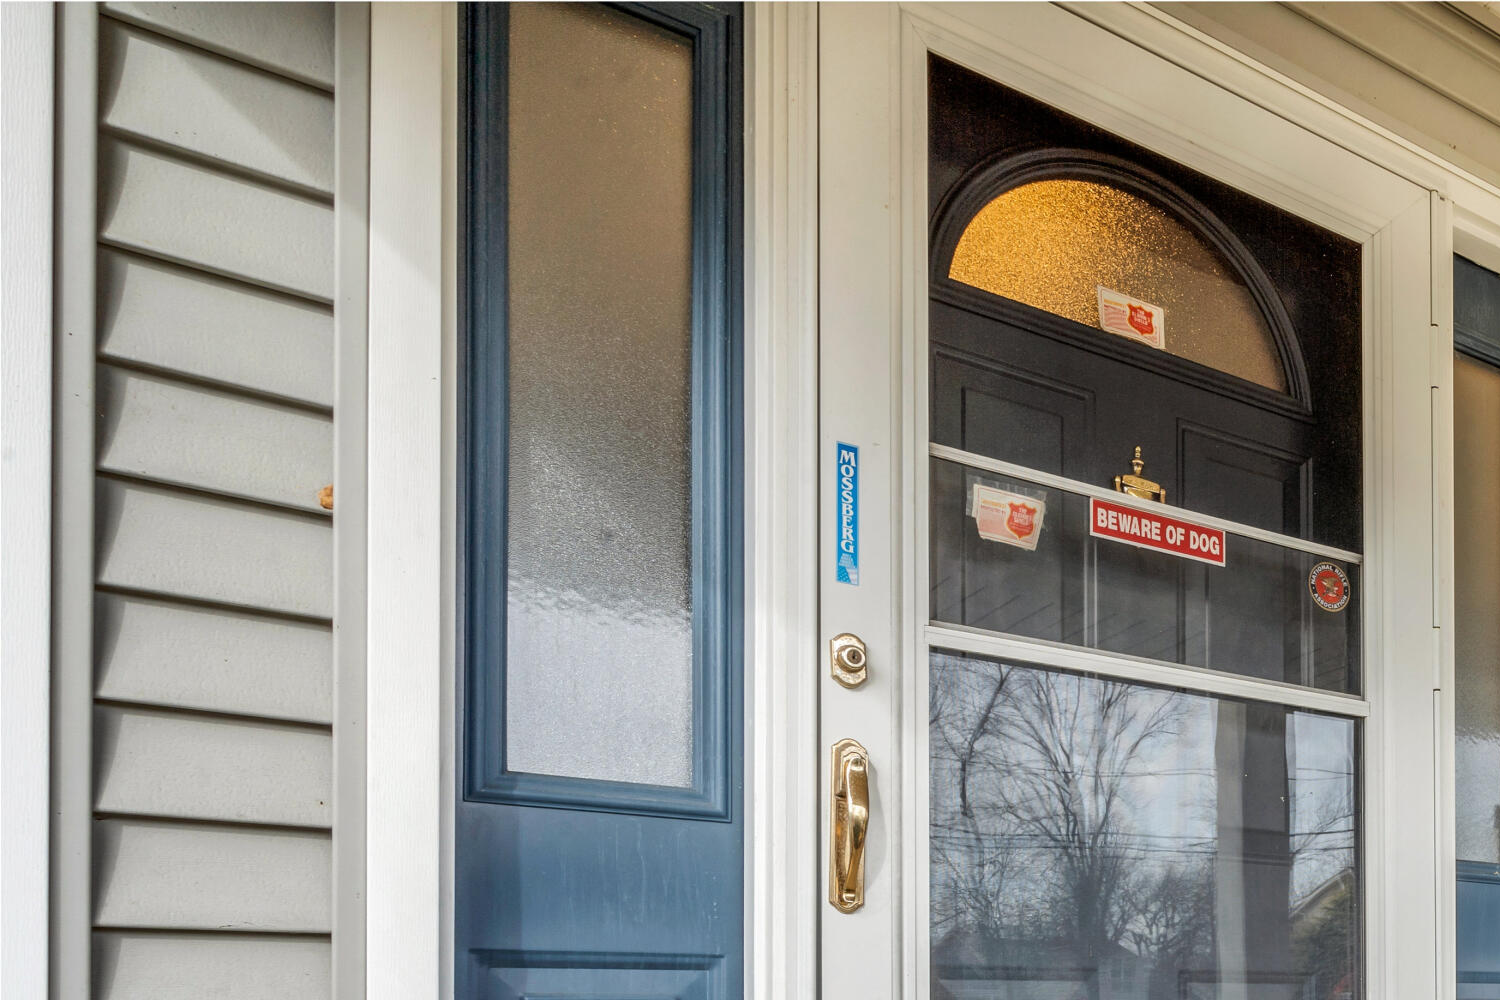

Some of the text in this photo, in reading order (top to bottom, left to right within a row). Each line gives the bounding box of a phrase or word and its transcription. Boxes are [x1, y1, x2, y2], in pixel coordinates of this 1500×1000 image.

[839, 449, 857, 554] MOSSBERG
[1097, 507, 1220, 556] BEWARE OF DOG
